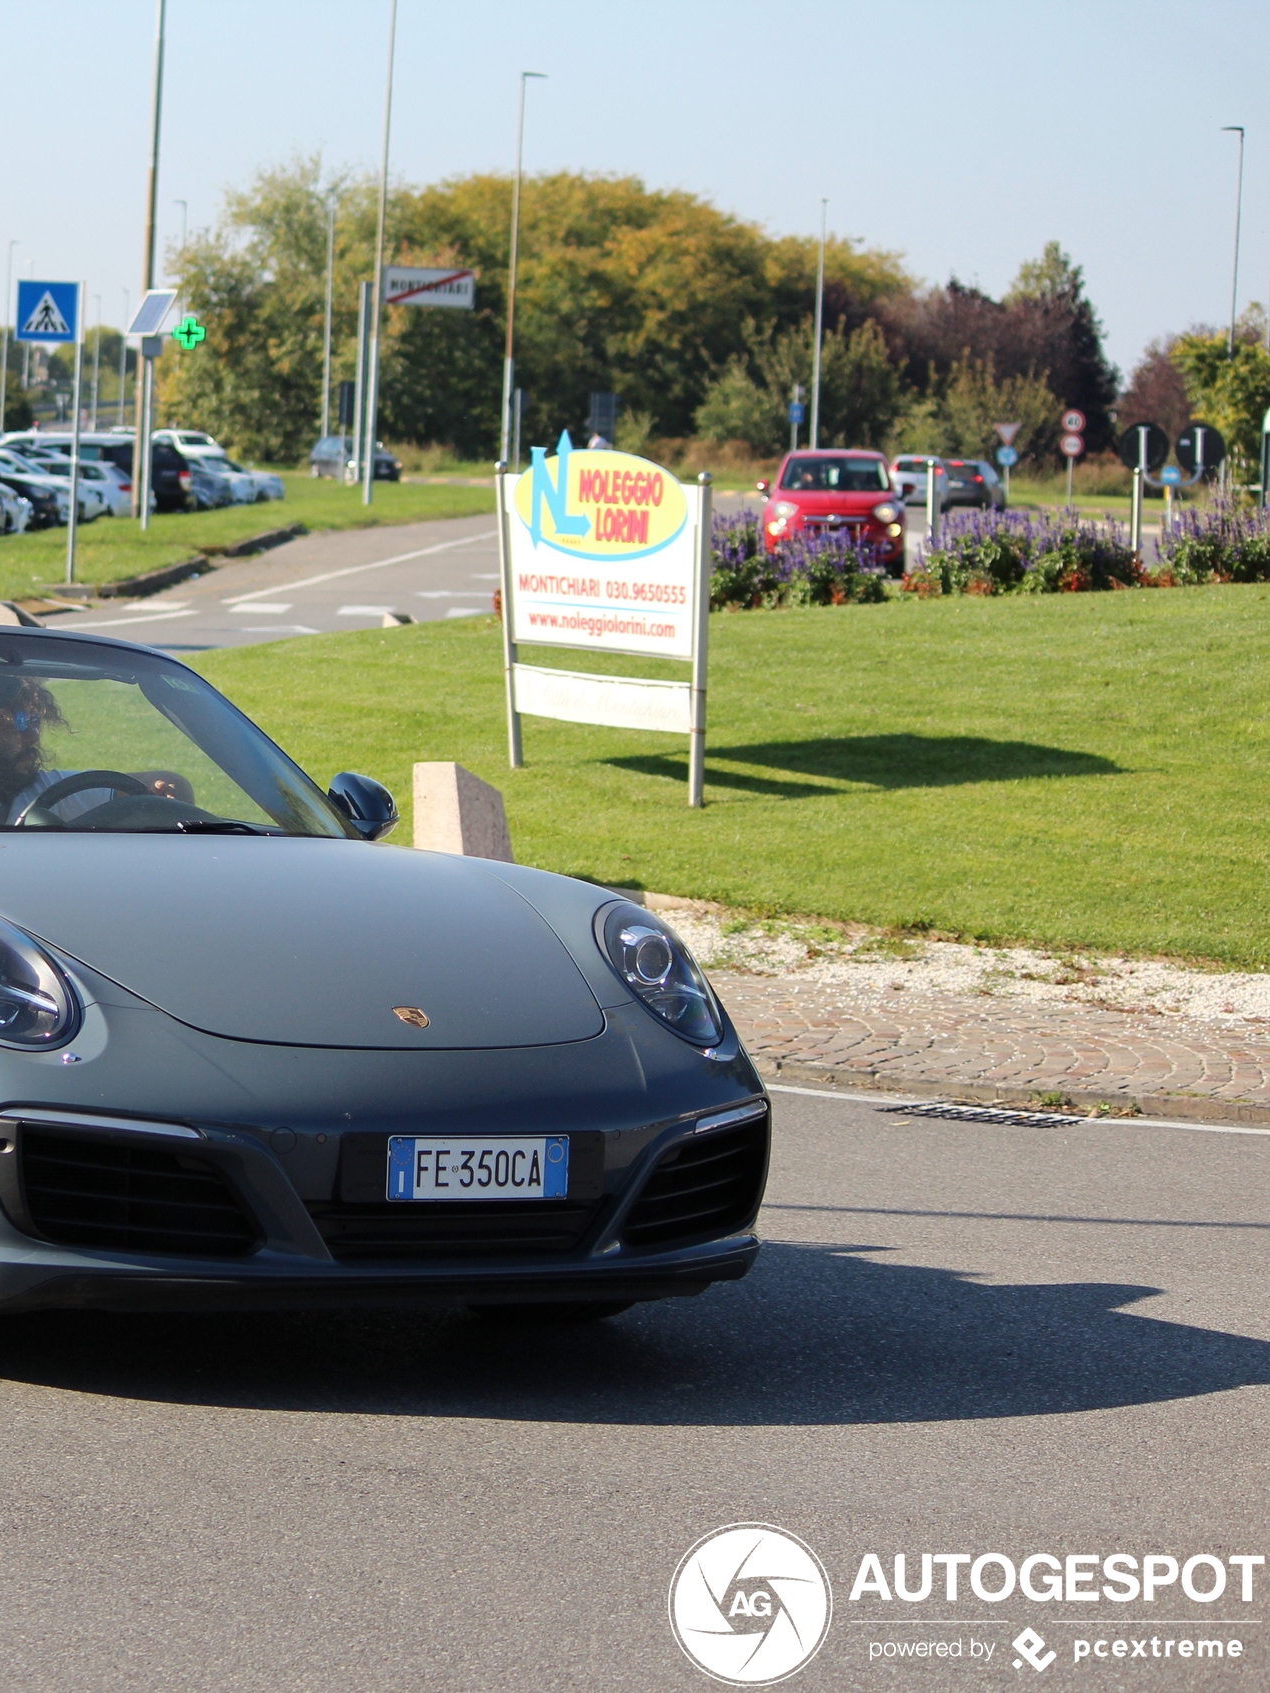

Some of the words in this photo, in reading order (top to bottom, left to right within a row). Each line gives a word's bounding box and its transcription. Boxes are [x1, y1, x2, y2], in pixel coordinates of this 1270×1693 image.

[579, 469, 664, 506] NOLEGGIO
[595, 507, 650, 544] LORINI
[519, 574, 600, 598] MONTICHIARI
[606, 581, 686, 604] 030.9650555
[529, 610, 676, 638] www.noleggiolorini.com
